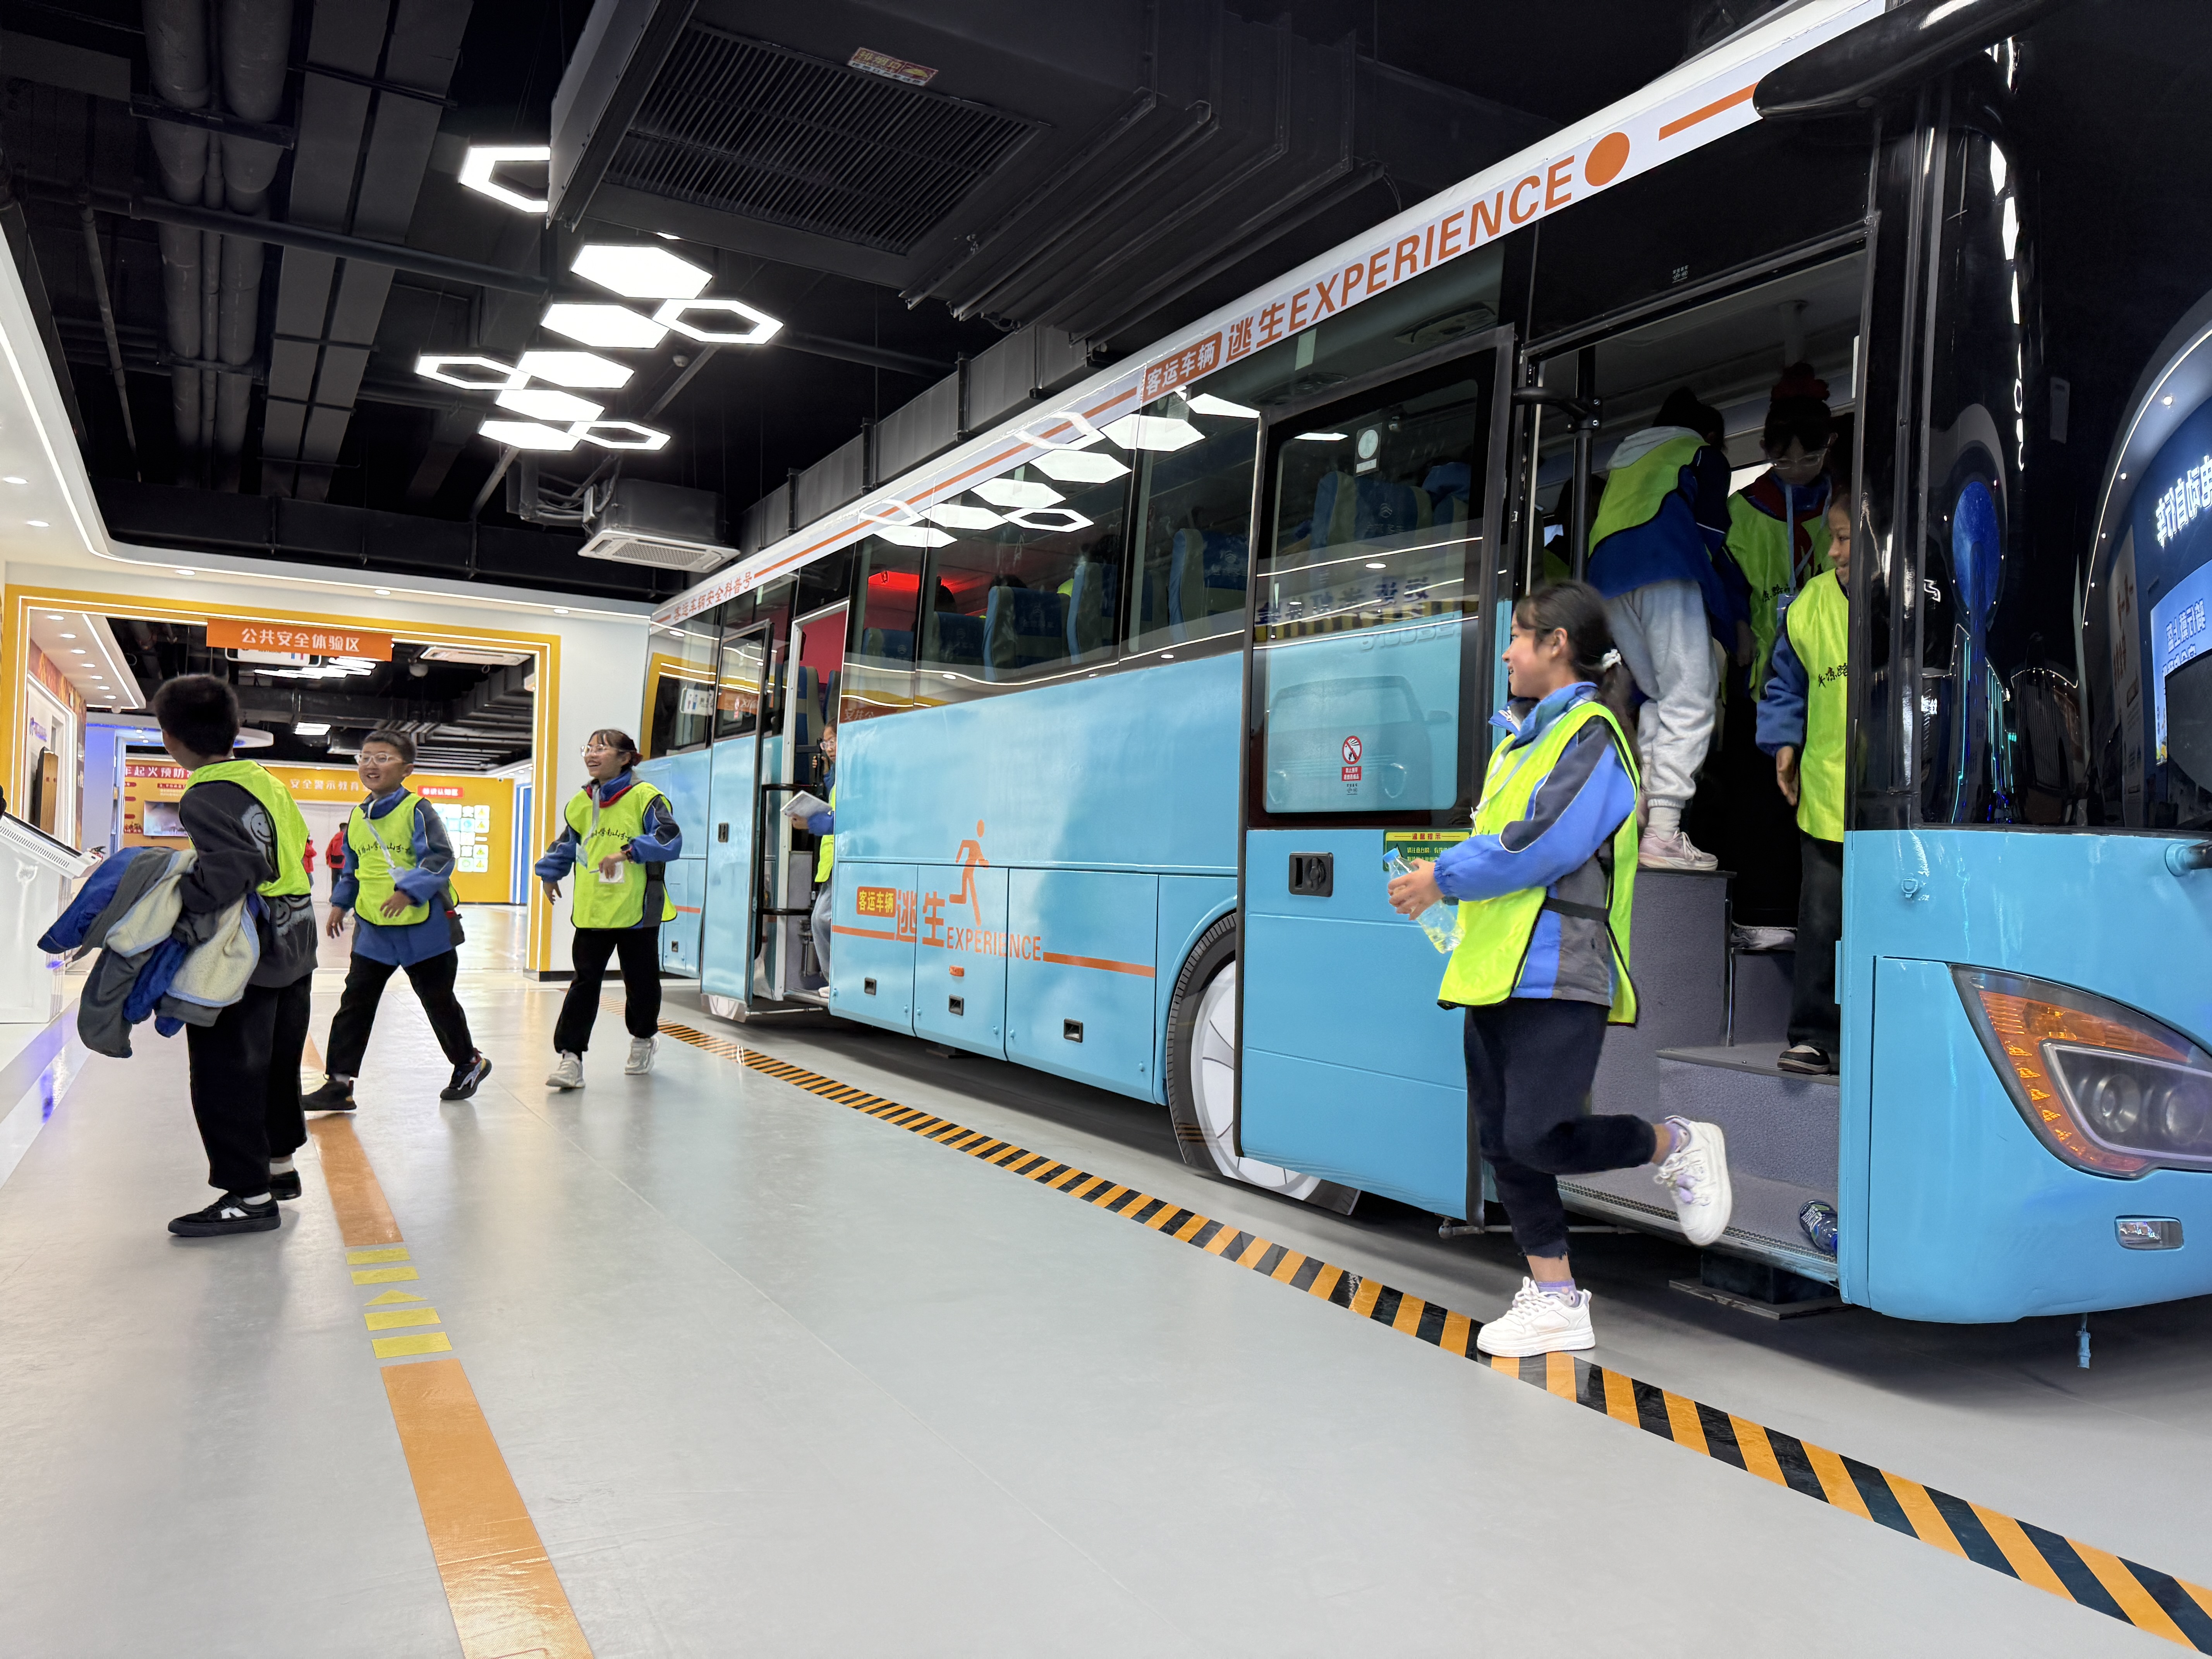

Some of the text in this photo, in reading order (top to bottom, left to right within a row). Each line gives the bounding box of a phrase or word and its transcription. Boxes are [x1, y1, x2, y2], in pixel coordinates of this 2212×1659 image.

[858, 50, 903, 70] 排烟口
[1146, 155, 1575, 396] 客运车辆 逃生 EXPERIENCE
[673, 571, 752, 621] 客运车辆安全科普号
[241, 628, 360, 652] 公共安全体验区
[859, 889, 1041, 961] 客运车辆 逃生 EXPERIENCE
